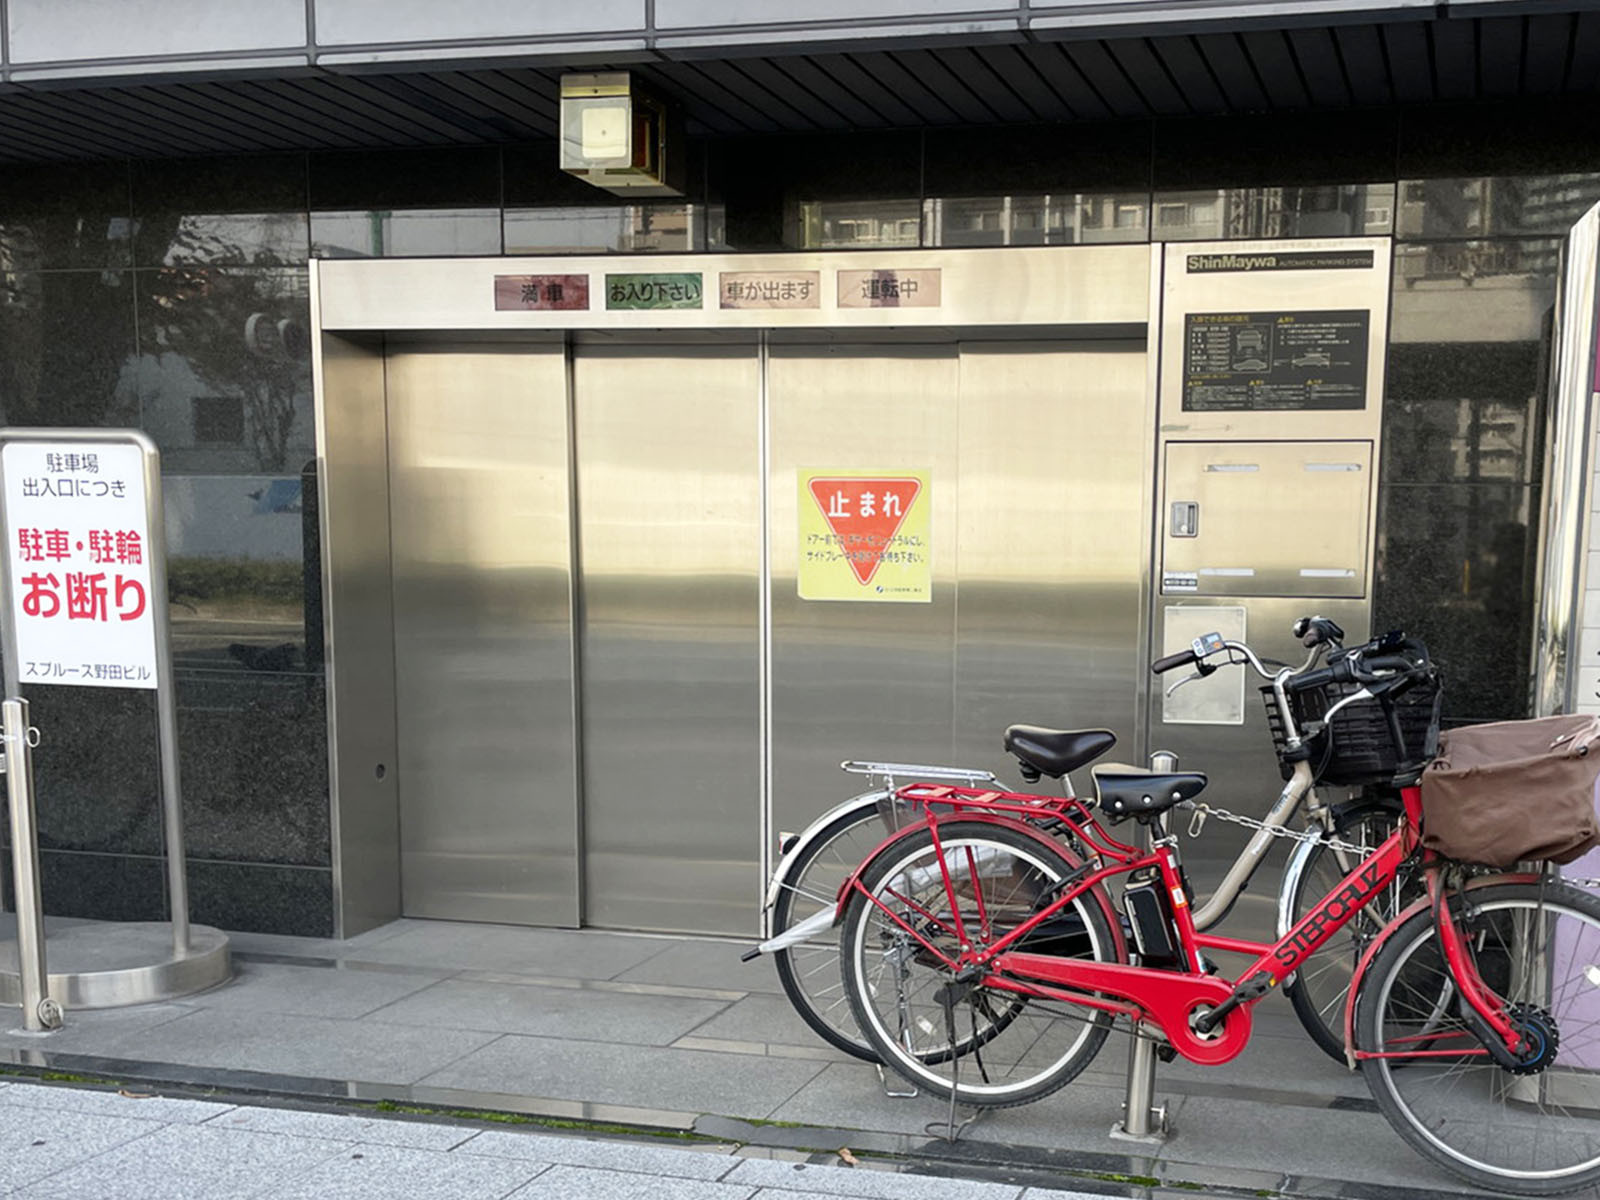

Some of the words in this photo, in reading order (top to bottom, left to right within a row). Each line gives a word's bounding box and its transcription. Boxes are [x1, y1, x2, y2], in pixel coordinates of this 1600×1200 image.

[1188, 255, 1276, 270] ShinMaywa
[521, 282, 564, 303] 満車
[610, 282, 699, 302] お入り下さい
[727, 279, 815, 301] 車が出ます
[861, 277, 919, 300] 運転中
[46, 453, 99, 474] 駐車場
[22, 477, 126, 498] 出入口につき
[827, 490, 902, 518] 止まれ
[18, 528, 143, 565] 駐車・駐輪
[21, 571, 146, 622] お断り
[1274, 862, 1389, 967] STEPCRUZ
